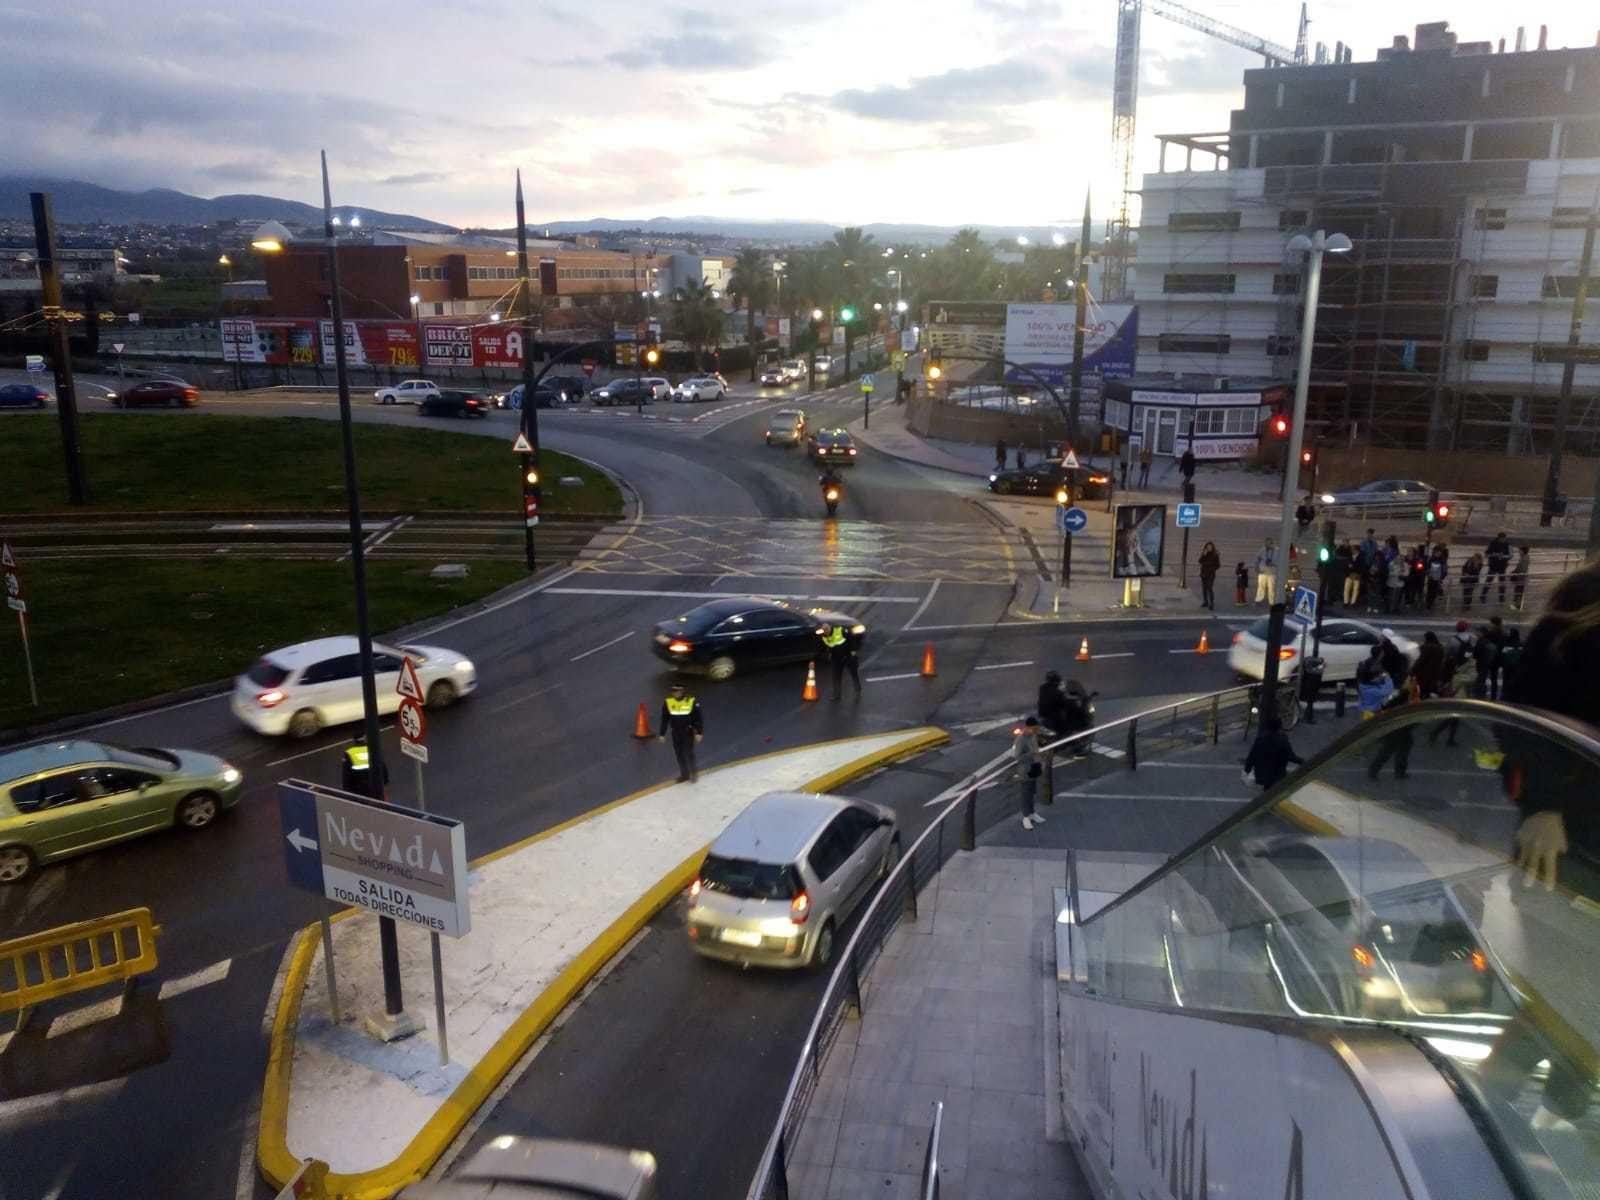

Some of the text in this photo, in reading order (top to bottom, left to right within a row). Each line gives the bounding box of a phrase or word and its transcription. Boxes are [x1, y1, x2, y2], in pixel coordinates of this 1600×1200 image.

[358, 856, 414, 880] SHOPPING
[334, 887, 445, 931] TODAS DIRECCIONES
[359, 880, 415, 909] SALIDA
